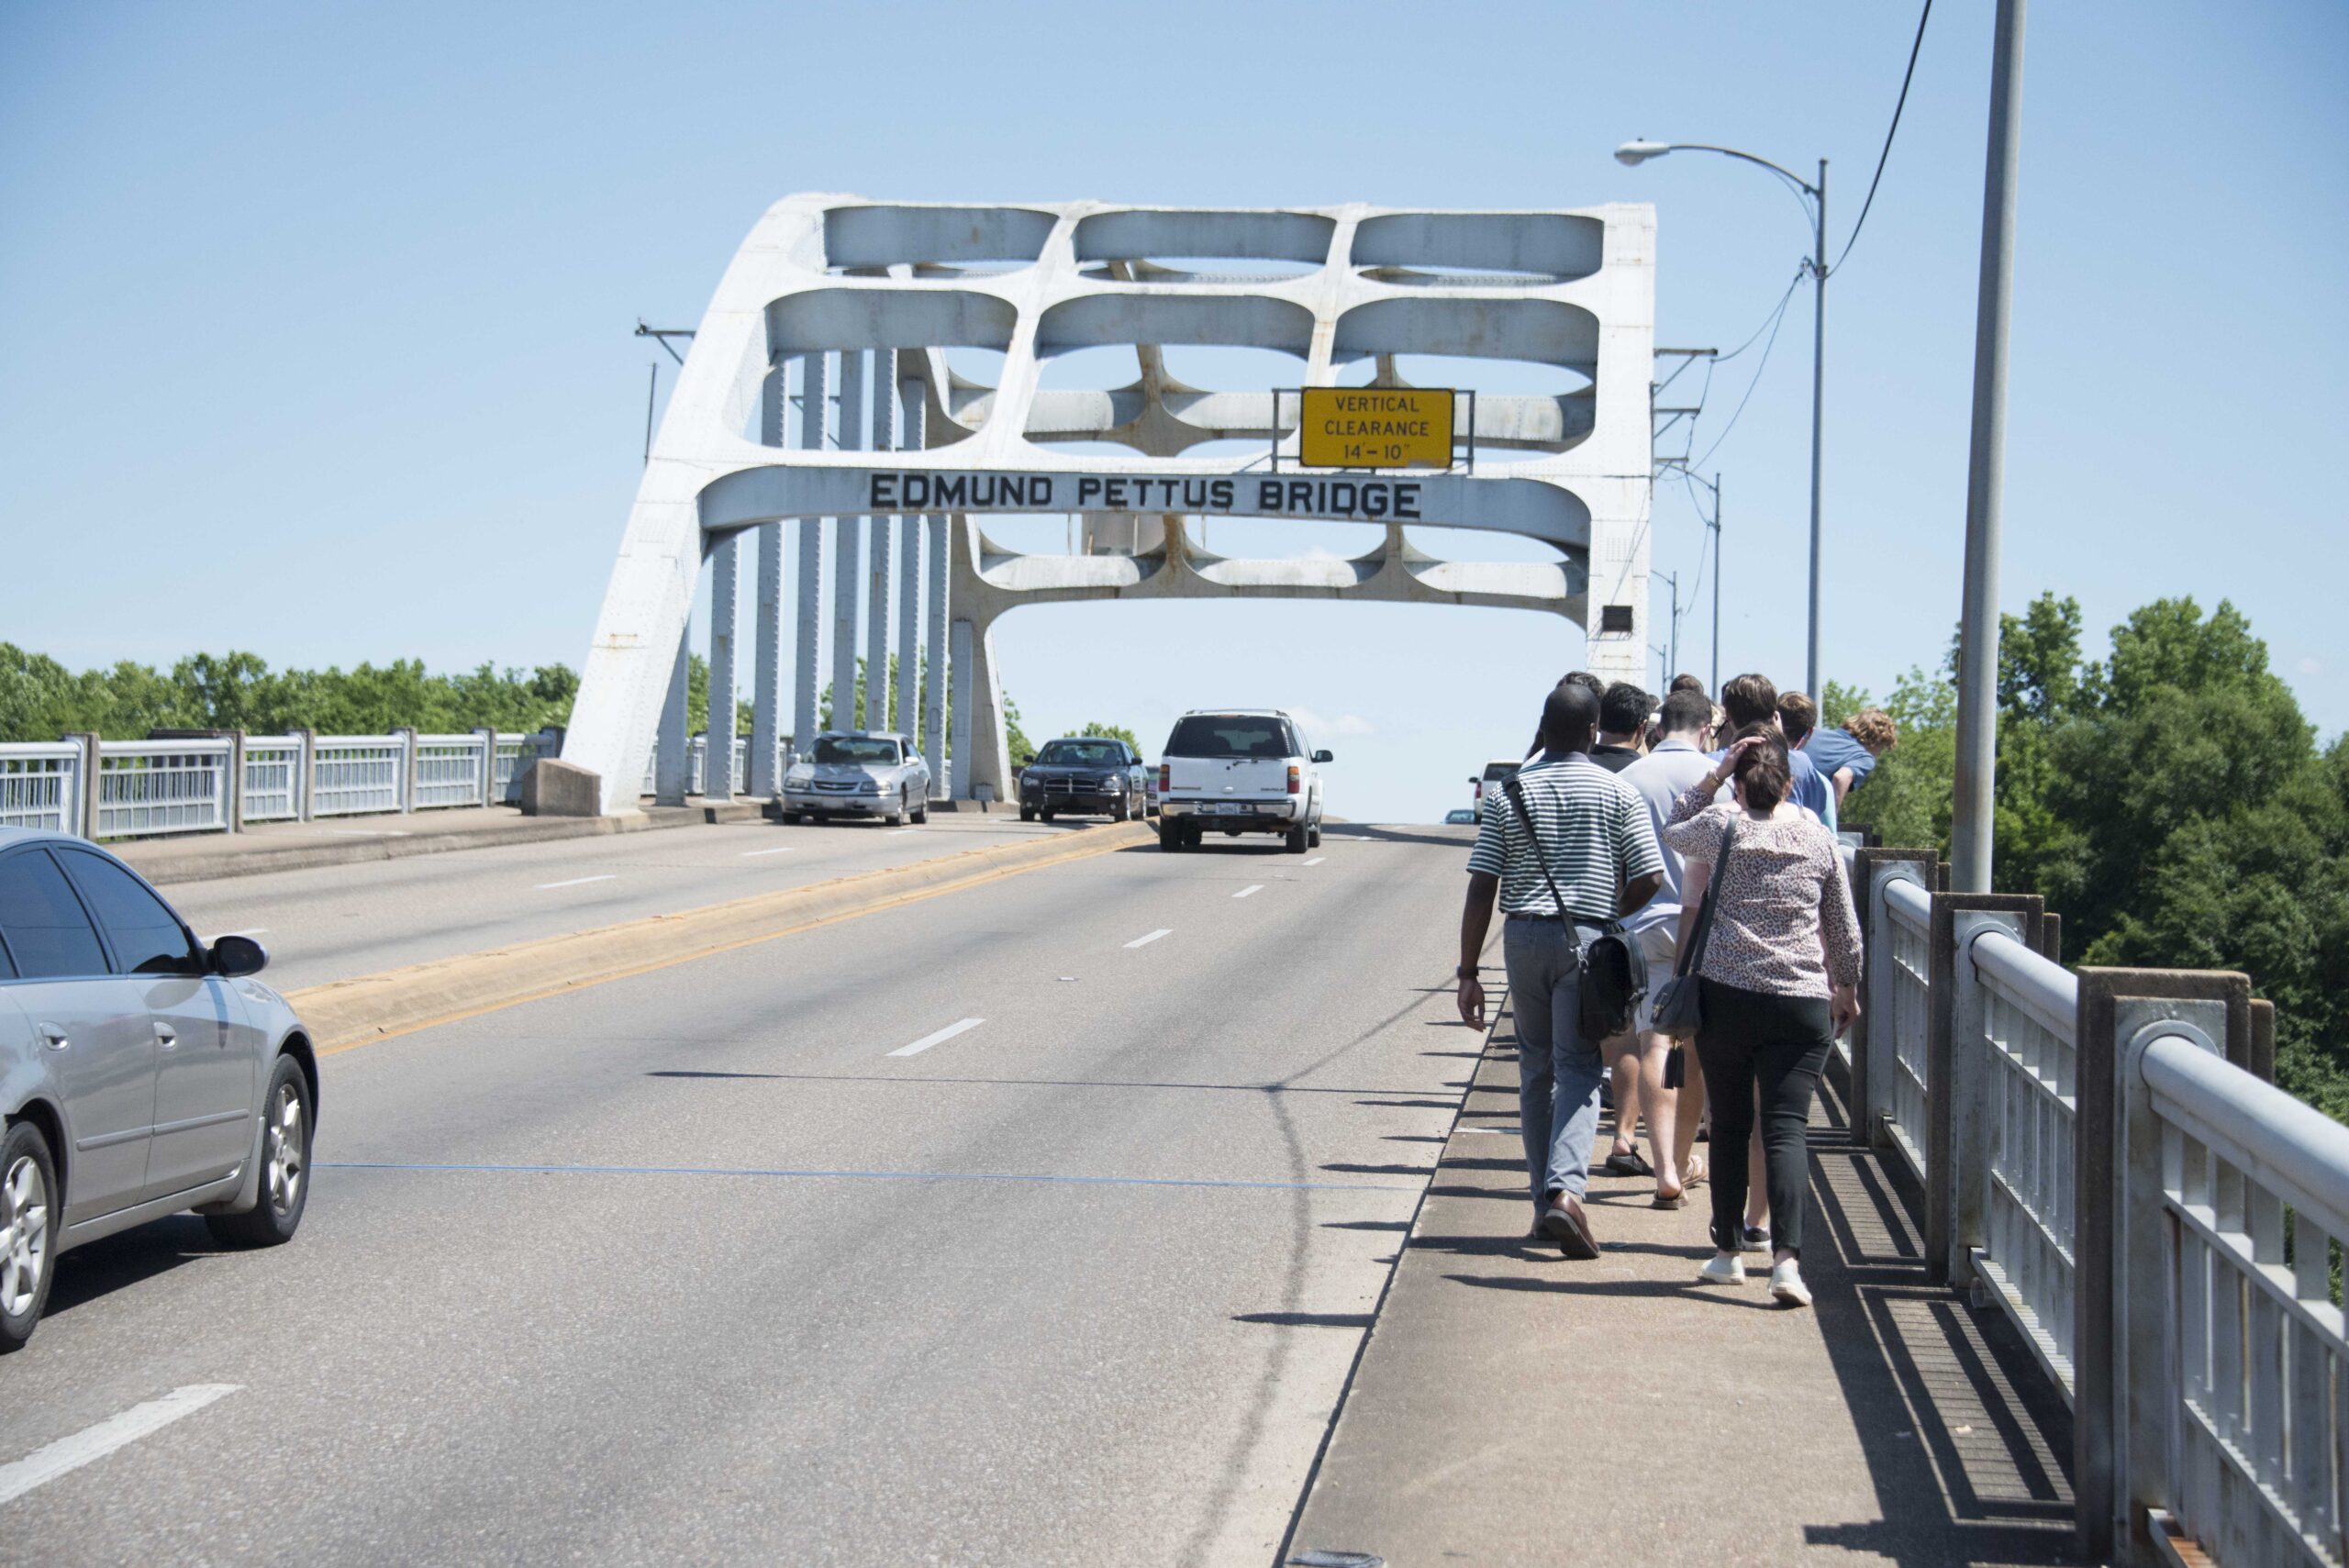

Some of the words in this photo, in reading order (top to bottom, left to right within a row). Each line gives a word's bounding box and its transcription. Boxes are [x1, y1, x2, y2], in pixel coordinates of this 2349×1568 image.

[1336, 396, 1419, 412] VERTICAL
[1325, 420, 1429, 436] CLEARANCE
[871, 473, 1052, 508] EDMUND
[1078, 478, 1234, 506] PETTUS
[1259, 481, 1420, 518] BRIDGE
